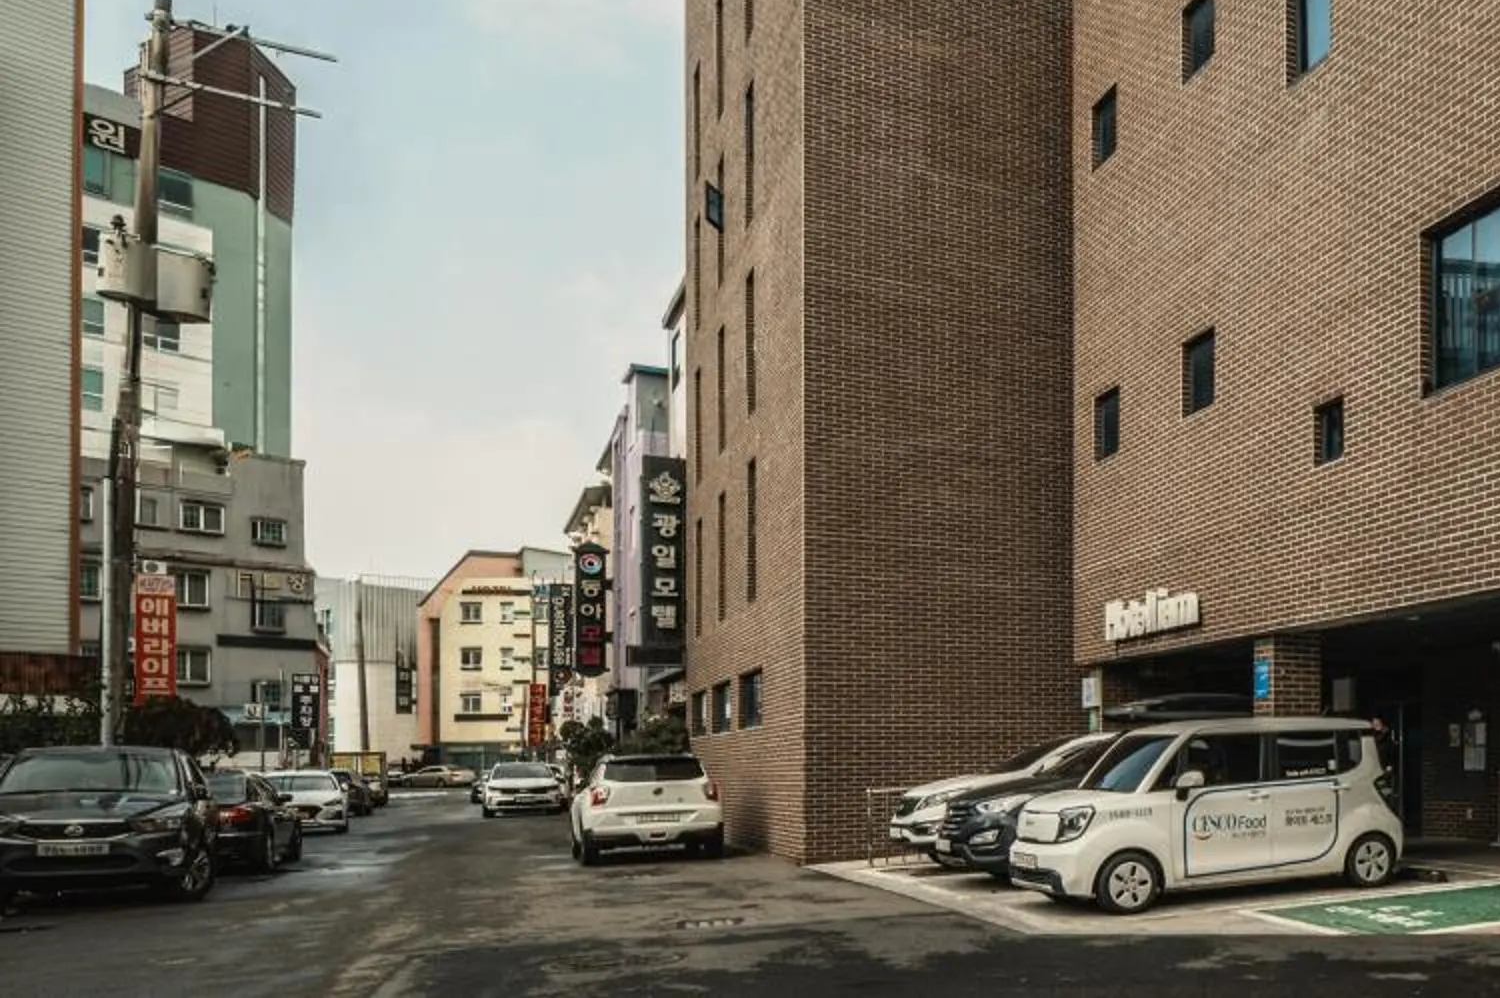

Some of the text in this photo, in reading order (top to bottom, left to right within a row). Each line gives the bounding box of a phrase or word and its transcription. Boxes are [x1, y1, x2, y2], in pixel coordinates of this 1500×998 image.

[88, 118, 126, 154] 원
[650, 512, 681, 630] 광일모텔
[140, 596, 173, 695] 에버라이프
[1238, 814, 1267, 830] Food
